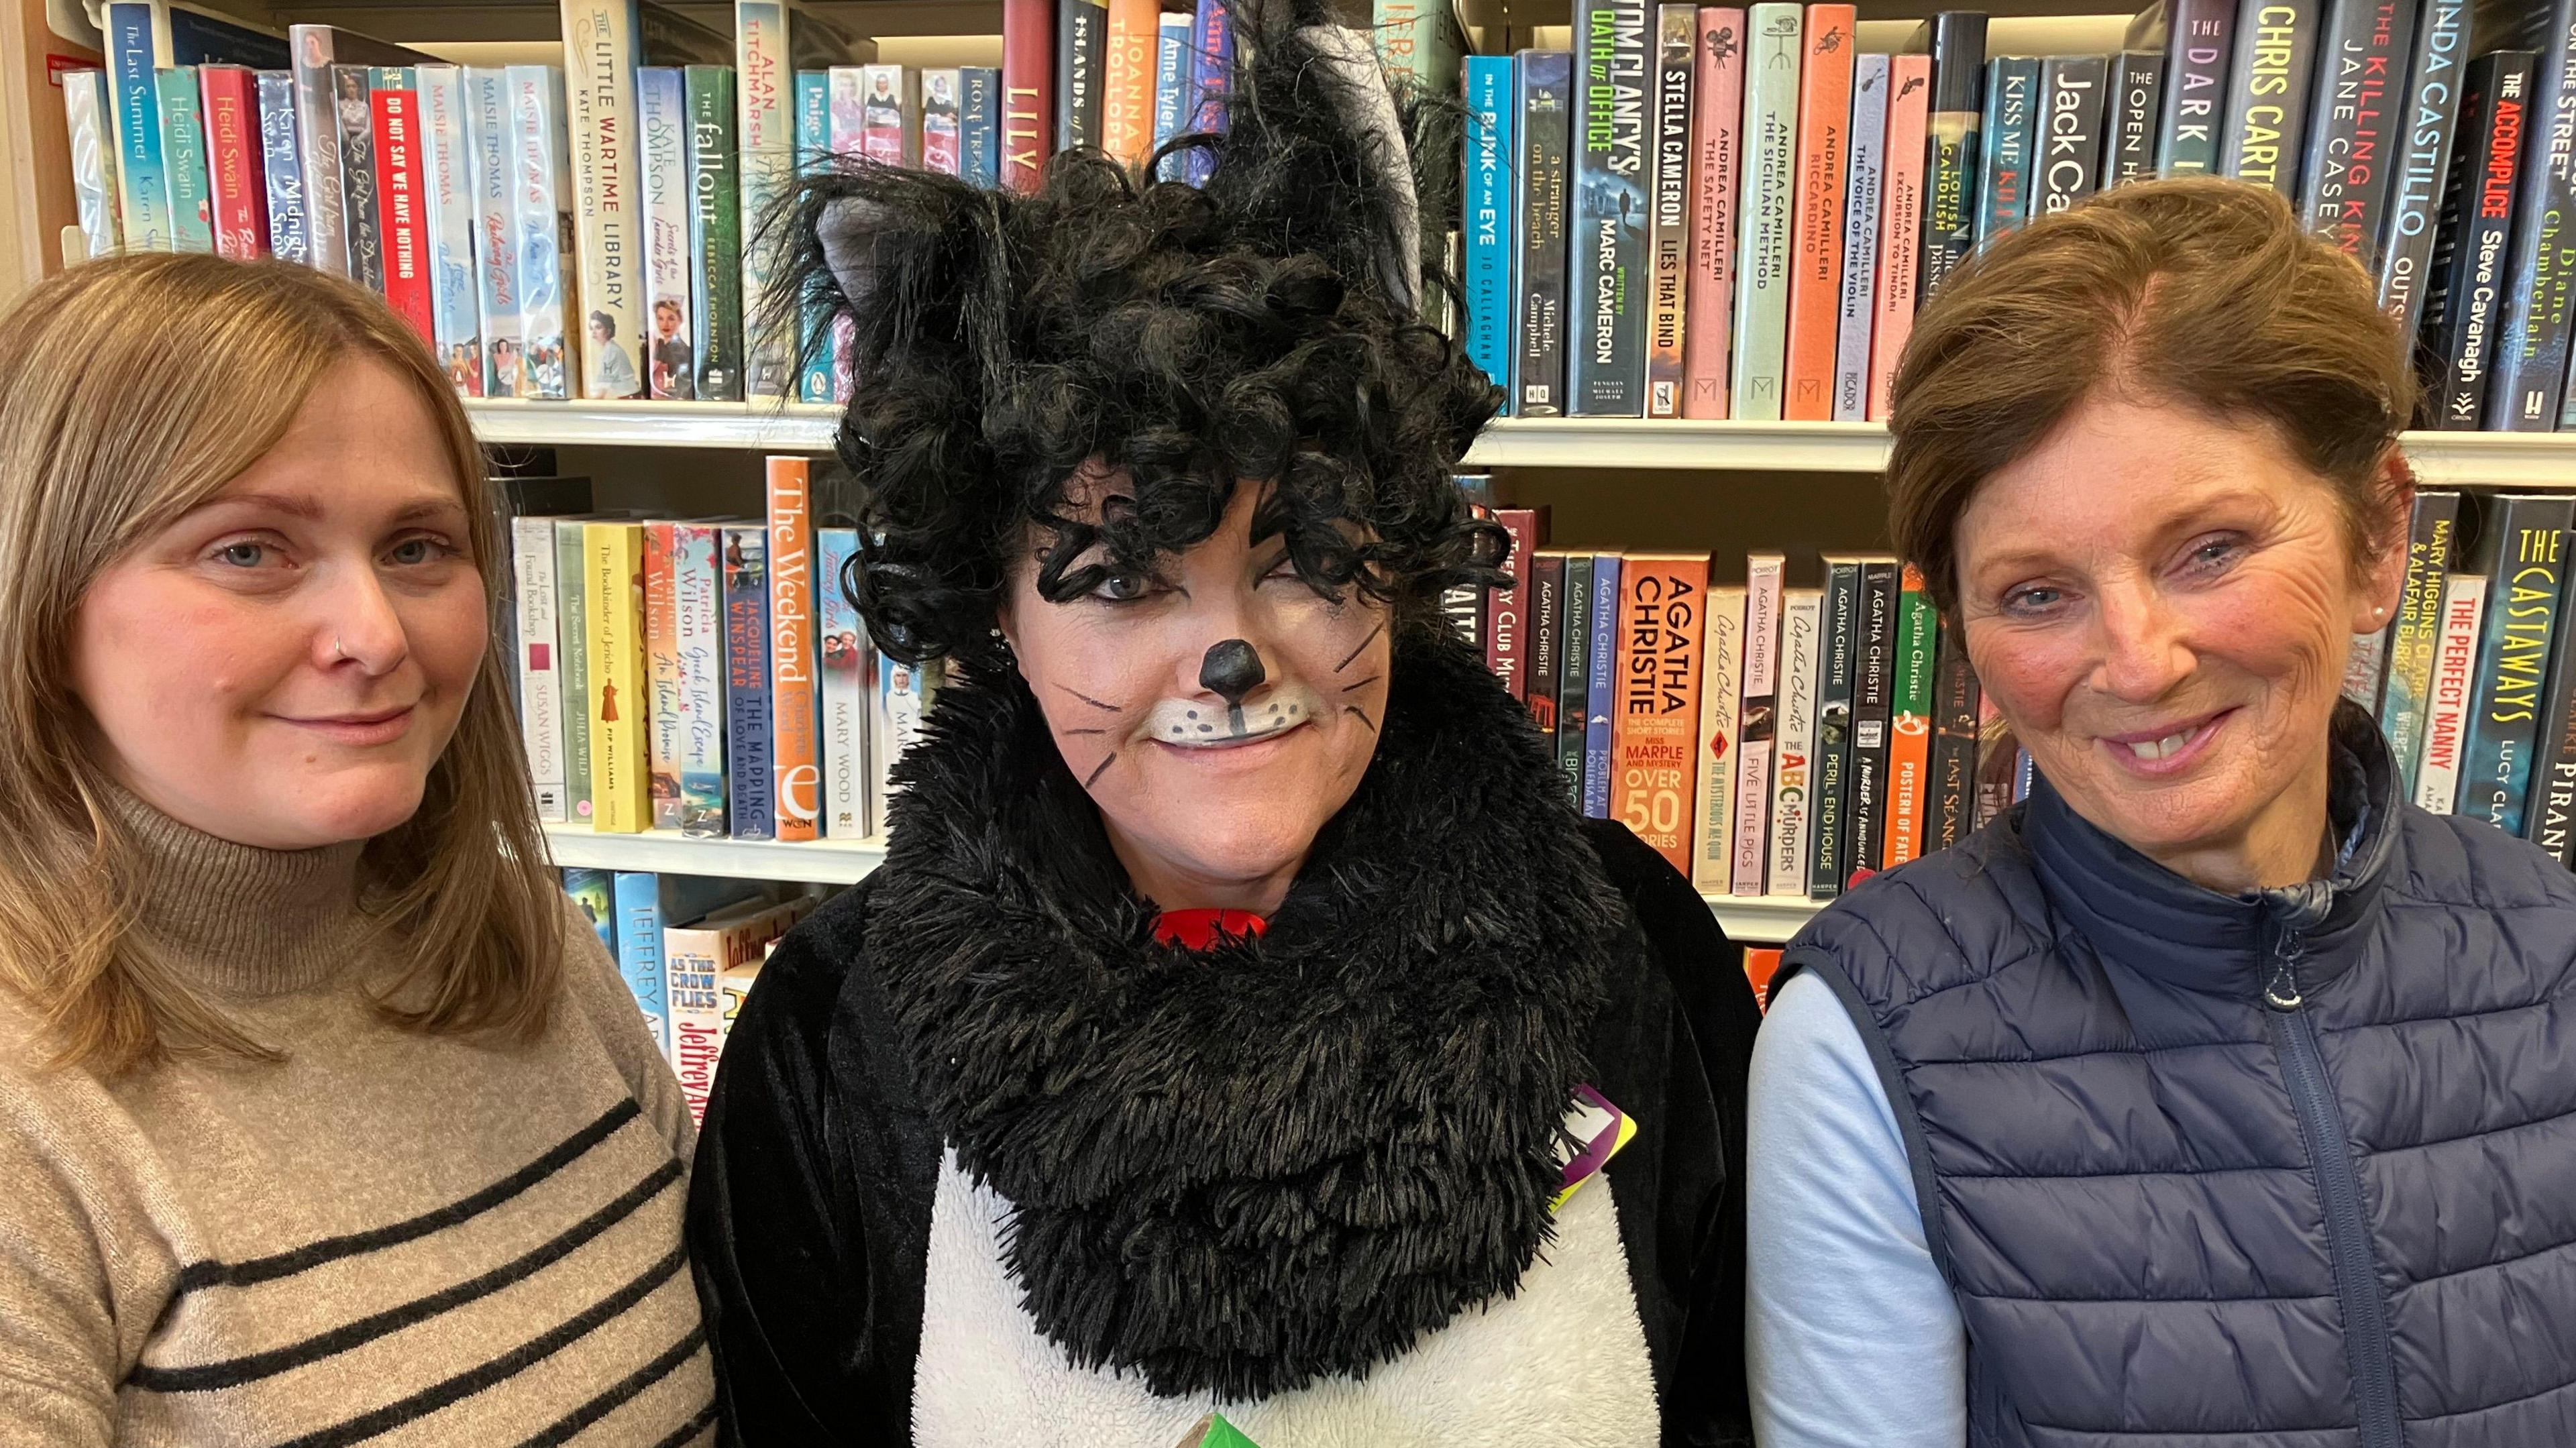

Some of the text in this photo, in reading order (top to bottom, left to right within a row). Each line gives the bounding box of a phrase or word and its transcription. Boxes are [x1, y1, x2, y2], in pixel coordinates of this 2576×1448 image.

[1074, 14, 1087, 109] ISLANDS
[2192, 20, 2222, 36] THE
[2249, 6, 2296, 97] CHRIS
[386, 97, 402, 114] DO
[747, 19, 762, 147] TITCHMARSH
[761, 56, 775, 111] ALAN
[808, 87, 824, 136] Paige
[1106, 18, 1126, 150] TROLLOPE
[1125, 32, 1144, 142] JOANNA
[1588, 10, 1615, 152] OATH OFFICE
[2051, 72, 2092, 156] Jack
[2129, 71, 2153, 85] THE
[2176, 47, 2218, 142] DARK
[129, 85, 146, 162] Summer
[171, 97, 195, 199] Heidi Swain
[217, 97, 241, 199] Heidi Swain
[278, 108, 294, 162] Karen
[388, 118, 405, 142] NOT
[390, 145, 406, 168] SAY
[431, 85, 452, 205] MAISIE THOMAS
[482, 77, 502, 199] MAISIE THOMAS
[579, 90, 595, 217] KATE THOMPSON
[645, 85, 664, 205] THOMPSON
[662, 123, 676, 168] KATE
[1006, 86, 1039, 171] LILY
[2000, 75, 2026, 165] KISS ME
[2125, 89, 2147, 152] OPEN
[2316, 40, 2363, 240] JANE CASEY
[2347, 56, 2388, 186] KILLING
[2398, 82, 2449, 237] CASTILLO
[2550, 95, 2576, 180] STREET
[391, 171, 407, 190] WE
[393, 194, 411, 225] HAVE
[596, 42, 623, 309] LITTLE WARTIME LIBRARY
[1658, 70, 1686, 348] STELLA CAMERON LIES THAT BIND
[1701, 174, 1715, 236] SAFETY
[1713, 128, 1729, 281] ANDREA CAMILLERI
[1757, 111, 1776, 290] THE SICILIAN METHOD
[1771, 123, 1788, 279] ANDREA CAMILLERI
[1806, 154, 1820, 253] RICCARDINO
[1819, 125, 1835, 281] ANDREA CAMILLERI
[1935, 146, 1952, 231] CANDLISH
[1946, 171, 1962, 231] LOUISE
[395, 227, 414, 280] NOTHING
[694, 92, 724, 363] THE fallout THORNTON
[1479, 112, 1497, 360] BLINK EYE CALLAGHAN
[1846, 144, 1866, 318] THE VOICE THE VIOLIN
[1860, 166, 1876, 297] ANDREA CAMILLERI
[1888, 171, 1904, 313] EXCURSION TINDARI
[2457, 71, 2525, 382] THE ACCOMPLICE Steve Cavanagh
[1596, 219, 1616, 364] MARC CAMERON
[1900, 238, 1911, 300] CAMILLERI
[2524, 210, 2561, 358] Chamberlain
[2551, 247, 2576, 325] Diane
[1527, 292, 1542, 357] Campbell
[1543, 299, 1555, 352] Michele
[1844, 372, 1858, 411] PICADOR
[773, 477, 803, 543] The
[2520, 529, 2561, 563] THE
[525, 555, 540, 637] Found Bookshop
[539, 585, 550, 606] Lost
[601, 567, 613, 674] Bookbinder Jericho
[647, 571, 665, 640] Wilson
[680, 568, 698, 637] Wilson
[775, 548, 807, 683] Weekend
[1540, 581, 1552, 627] AGATHA
[1572, 581, 1584, 628] AGATHA
[2401, 555, 2424, 622] ALAFAIR
[2418, 519, 2451, 640] MARY HIGGINS
[2449, 598, 2476, 632] THE
[1538, 628, 1550, 677] CHRISTIE
[1570, 628, 1581, 677] CHRISTIE
[1595, 577, 1611, 689] AGATHA CHRISTIE
[1629, 575, 1661, 714] CHRISTIE
[1661, 575, 1693, 715] AGATHA
[1753, 587, 1768, 685] AGATHA CHRISTIE
[1832, 587, 1848, 686] AGATHA CHRISTIE
[1866, 589, 1884, 704] AGATHA CHRISTIE
[1909, 601, 1927, 702] Agatha Christie
[2438, 634, 2470, 708] PERFECT
[2491, 567, 2555, 722] CASTAWAYS
[537, 684, 551, 776] SUSAN WIGGS
[576, 711, 588, 776] JULIA WILD
[746, 598, 765, 821] JACQUELINE THE MAPPING
[1626, 727, 1684, 735] SHORT STORIES
[1643, 718, 1684, 727] COMPLETE
[1784, 741, 1803, 750] THE
[2428, 712, 2459, 771] NANNY
[836, 702, 851, 803] MARY WOOD
[1625, 769, 1682, 788] OVER
[1626, 746, 1684, 759] MARPLE
[1646, 760, 1682, 769] MYSTERY
[1899, 761, 1914, 815] POSTERN
[1947, 758, 1960, 791] LAST
[2496, 740, 2515, 785] LUCY
[1622, 789, 1680, 833] 50
[1743, 793, 1758, 834] LITTLE
[1780, 804, 1797, 872] MURDERS
[1820, 797, 1836, 871] END HOUSE
[629, 907, 658, 1005] JEFFREY
[671, 958, 686, 972] AS
[671, 972, 716, 990] CROW
[672, 989, 718, 1009] FLIES
